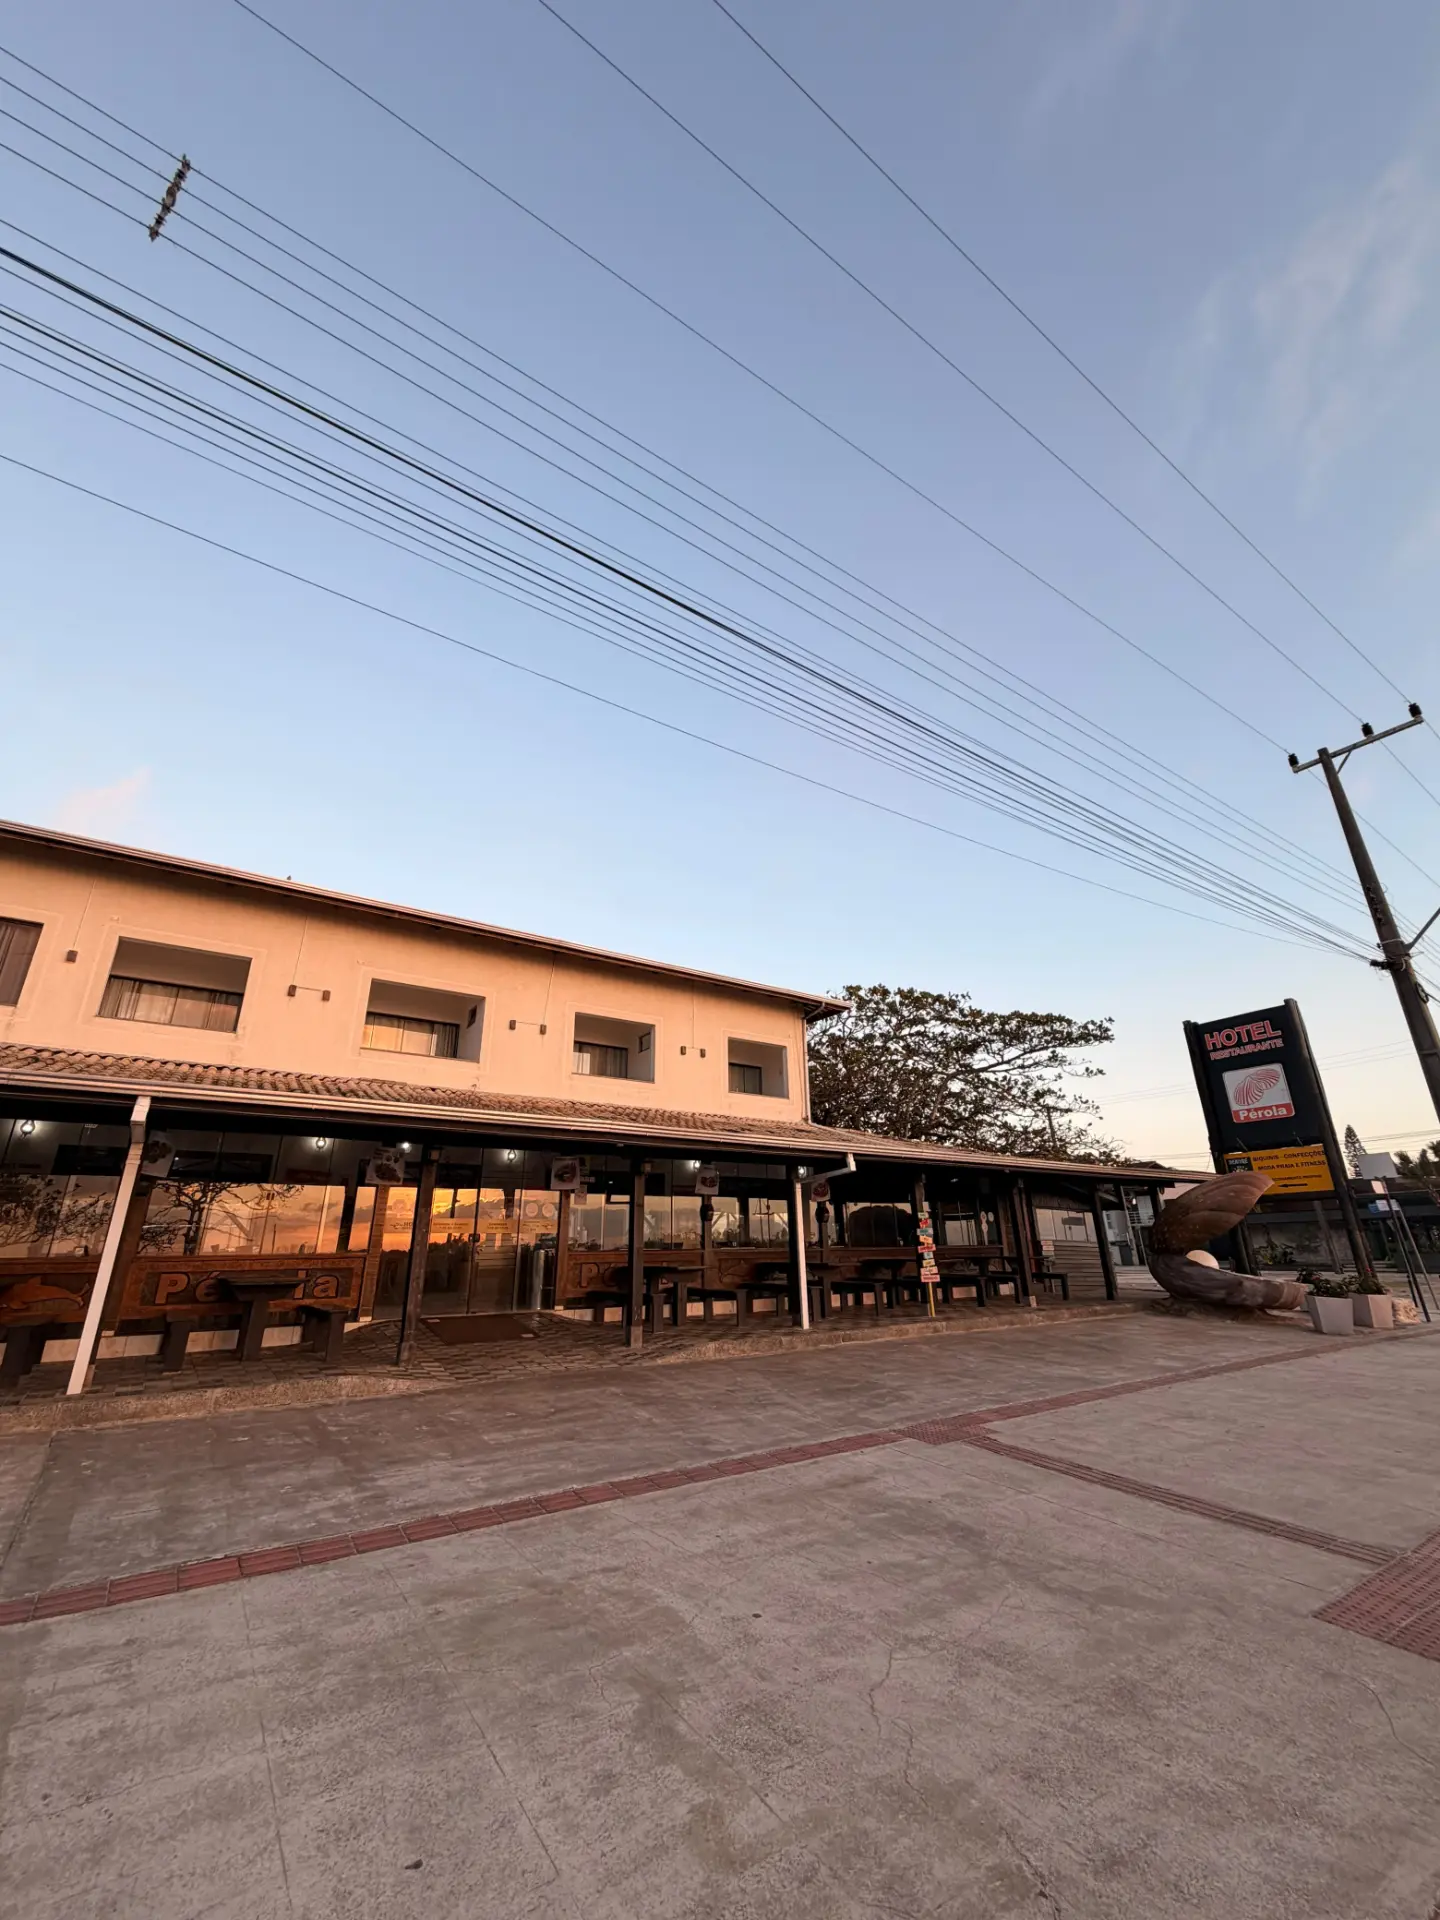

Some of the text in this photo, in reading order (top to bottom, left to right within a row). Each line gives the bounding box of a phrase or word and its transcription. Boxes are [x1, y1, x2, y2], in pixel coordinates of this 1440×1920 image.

[1204, 1020, 1282, 1050] HOTEL
[1209, 1038, 1284, 1060] RESTAURANTE
[1239, 1106, 1287, 1120] Pérola
[1283, 1150, 1325, 1159] CONFECÇÕES
